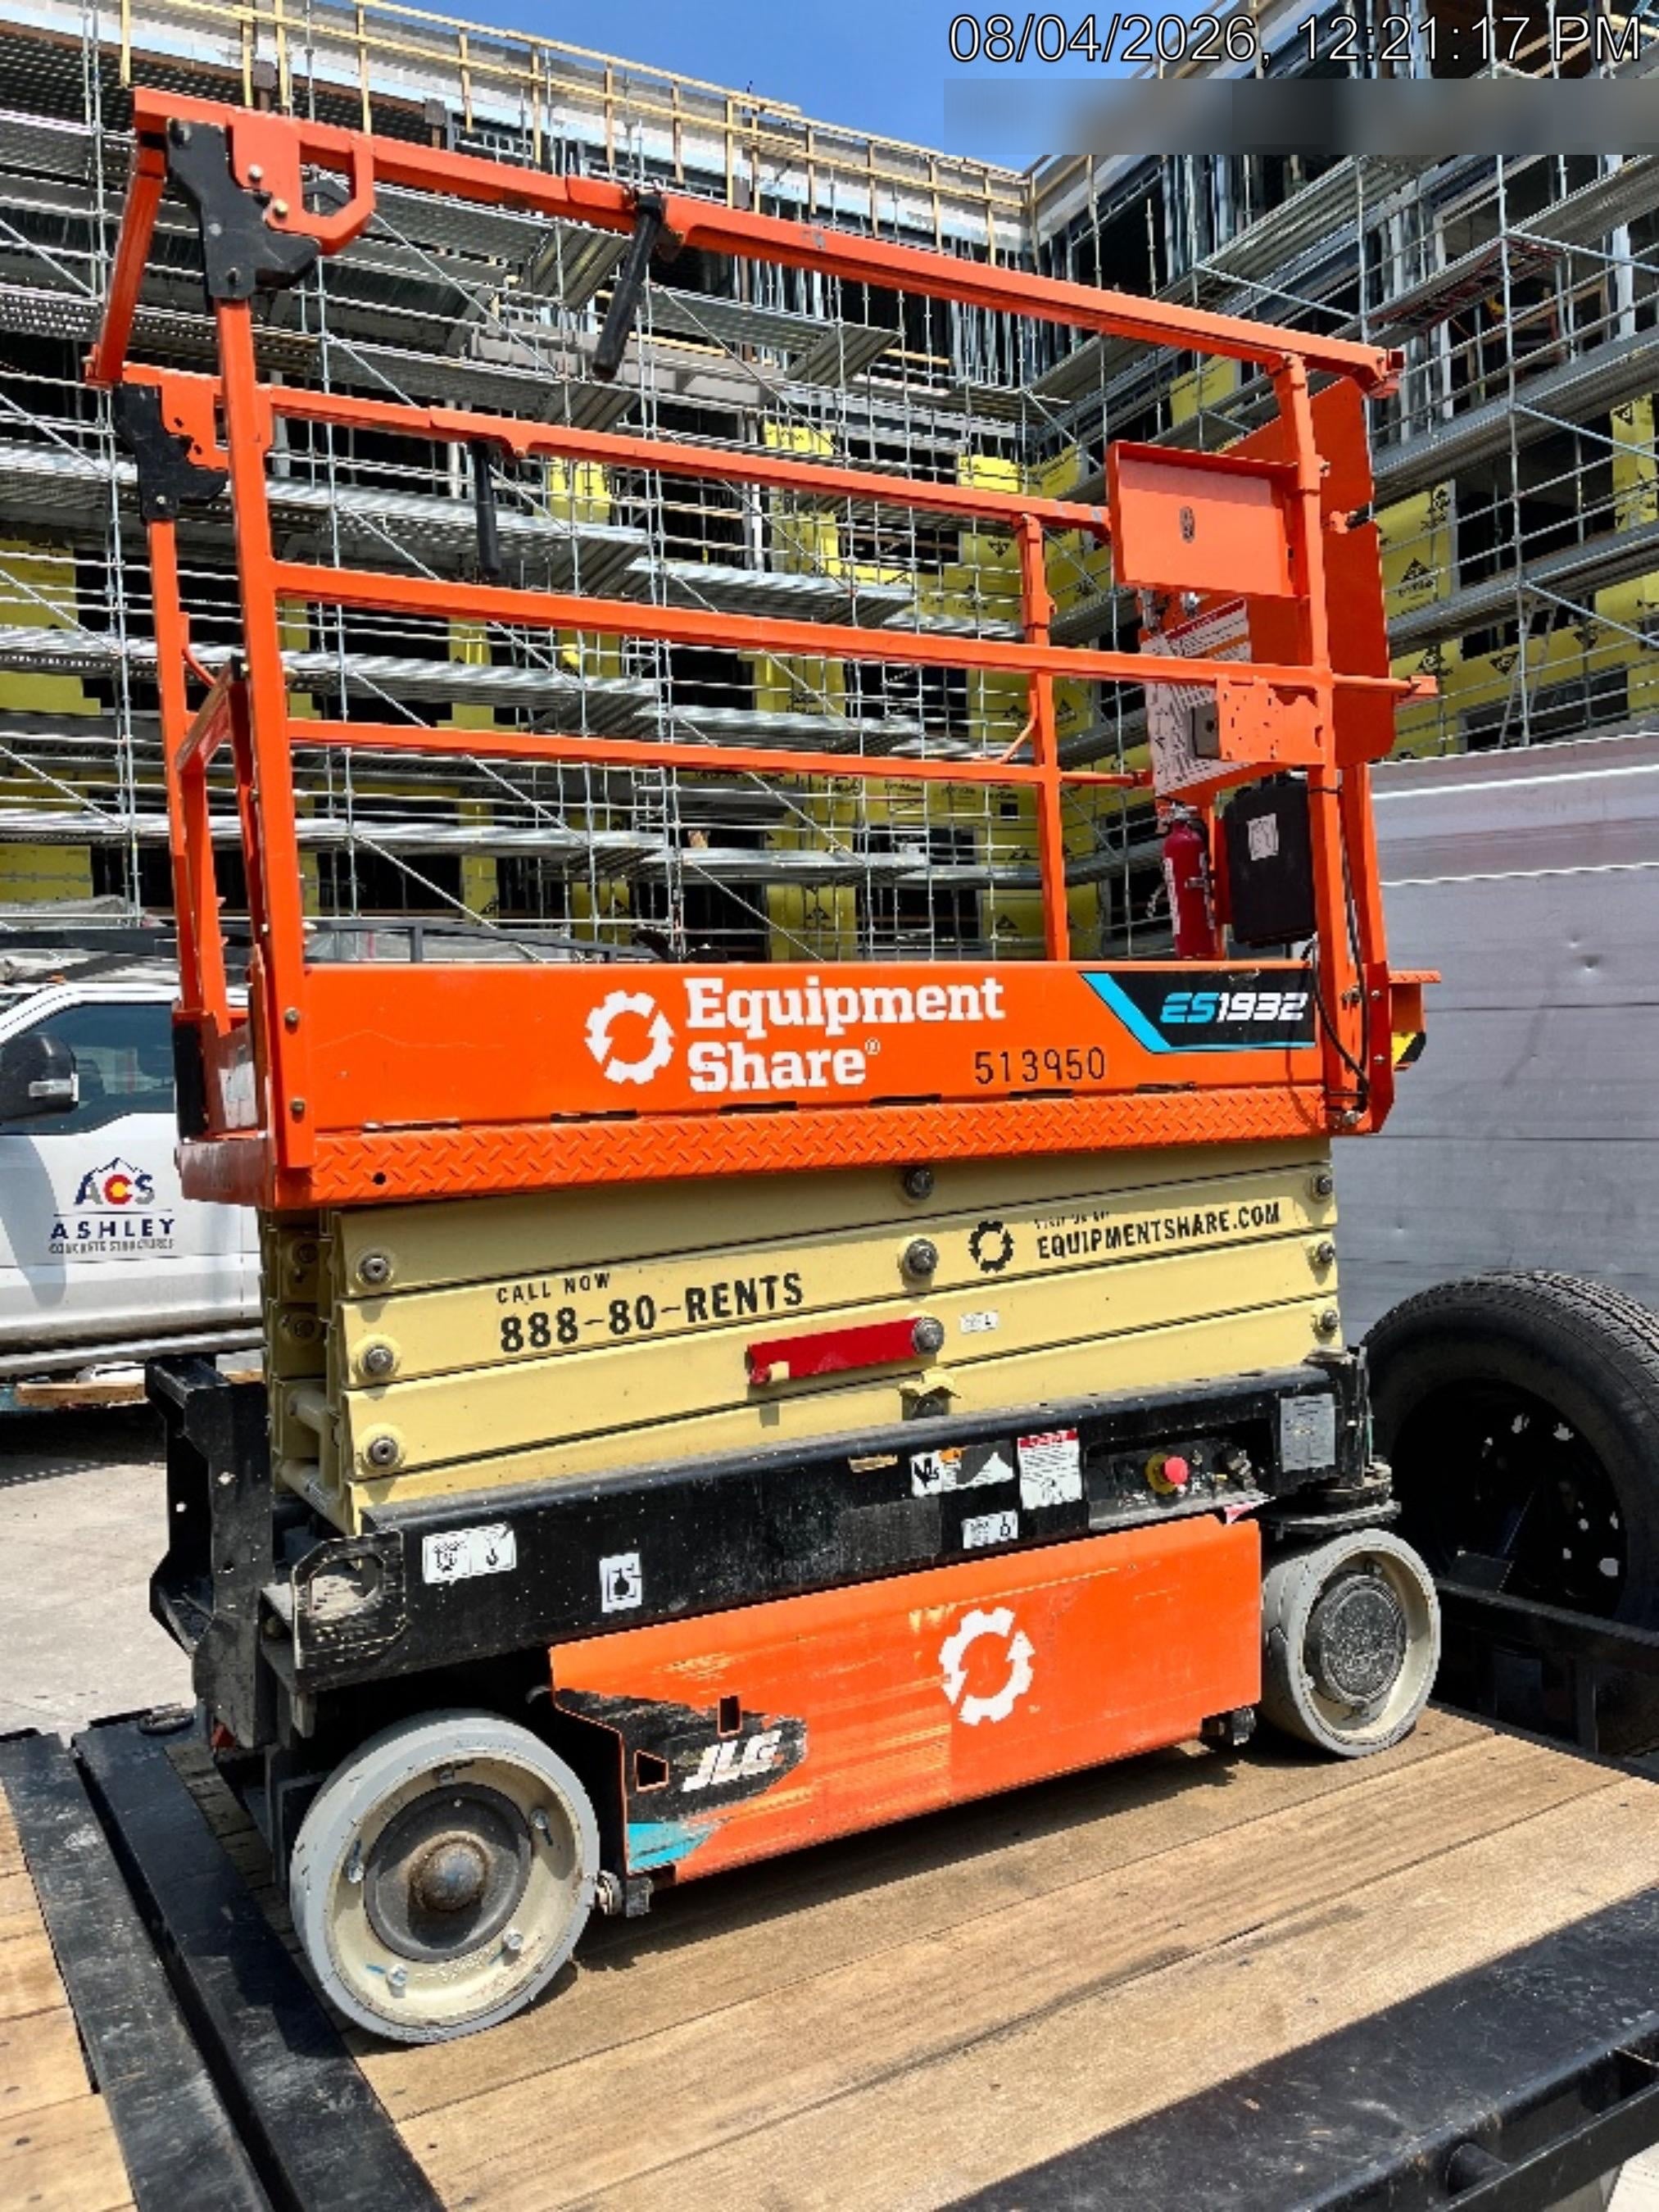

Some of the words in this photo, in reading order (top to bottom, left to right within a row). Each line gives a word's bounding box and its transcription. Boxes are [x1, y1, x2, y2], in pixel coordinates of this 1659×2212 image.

[683, 976, 1005, 1038] Equipment
[1161, 992, 1307, 1022] ES1932
[975, 1046, 1106, 1086] 513950
[74, 1173, 156, 1205] ACS
[50, 1218, 175, 1240] ASHLEY
[1037, 1201, 1281, 1259] EQUIPMENTSHARE.COM
[496, 1279, 552, 1304] CALL
[564, 1272, 611, 1294] NOW
[500, 1272, 804, 1353] 888-80-RENTS
[682, 1729, 782, 1793] JLG
